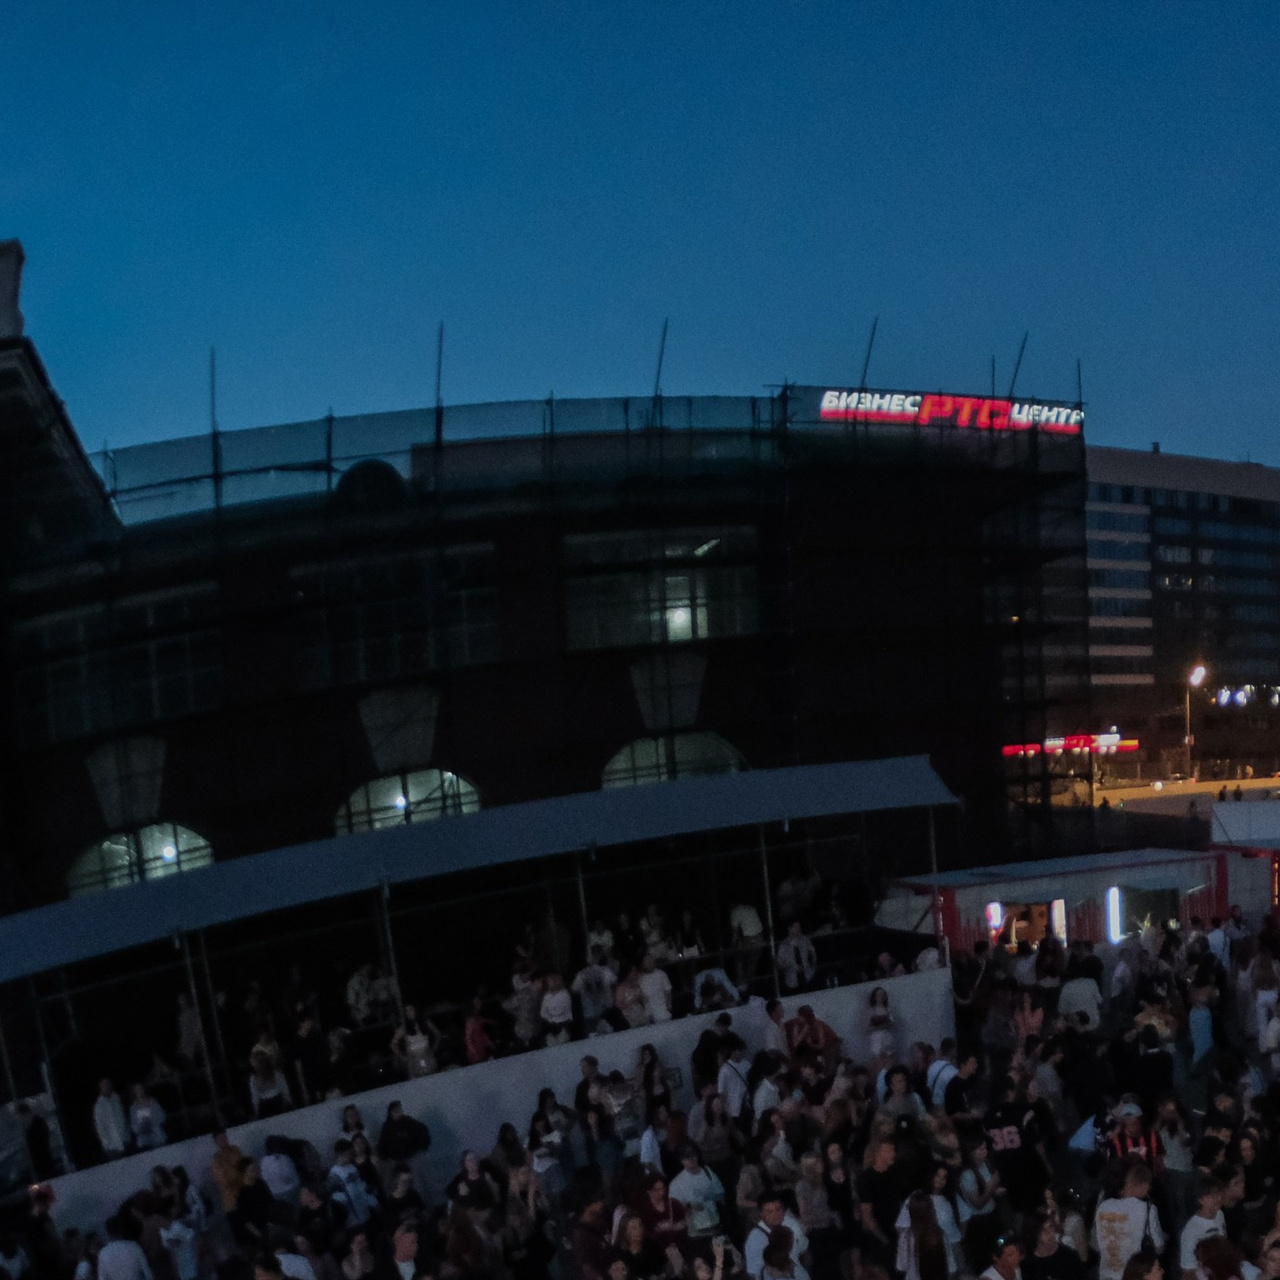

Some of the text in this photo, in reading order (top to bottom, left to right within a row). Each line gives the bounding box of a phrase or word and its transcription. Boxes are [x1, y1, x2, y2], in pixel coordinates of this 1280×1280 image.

[820, 390, 1085, 430] БИЗНЕС РТС ЦЕНТР
